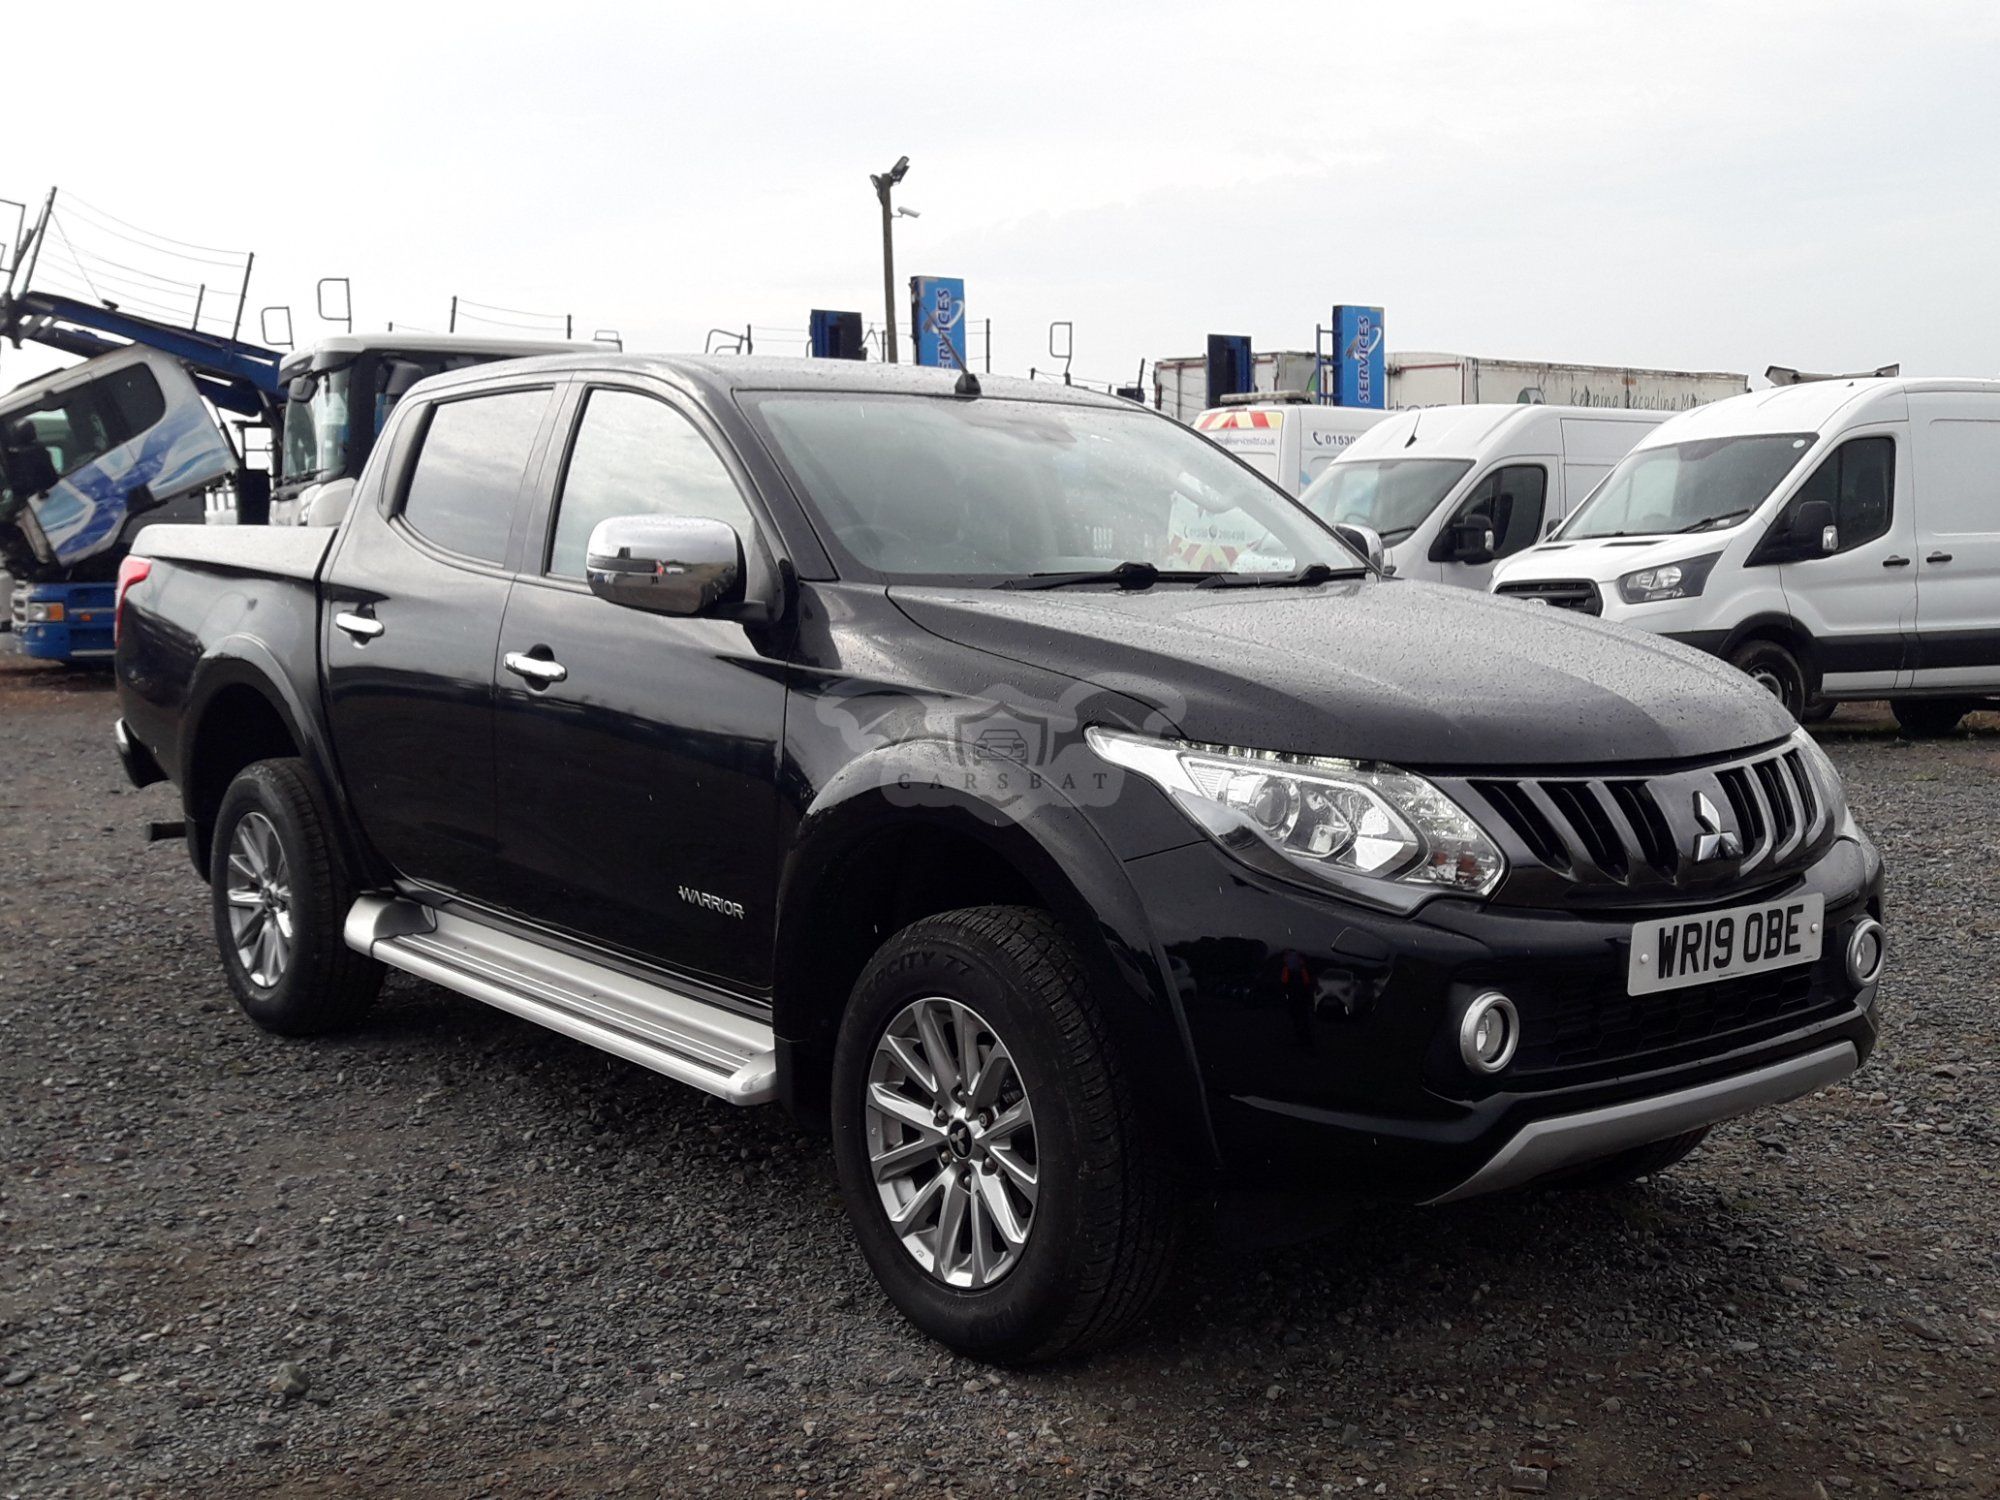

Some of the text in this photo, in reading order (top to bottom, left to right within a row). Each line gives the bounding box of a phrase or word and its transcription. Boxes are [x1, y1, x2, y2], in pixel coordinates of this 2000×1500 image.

[936, 288, 952, 369] ERVICES
[1358, 315, 1370, 403] SERVICES
[1325, 435, 1358, 446] 01530
[678, 885, 744, 920] WARRIOR
[1658, 904, 1804, 979] WR19 OBE
